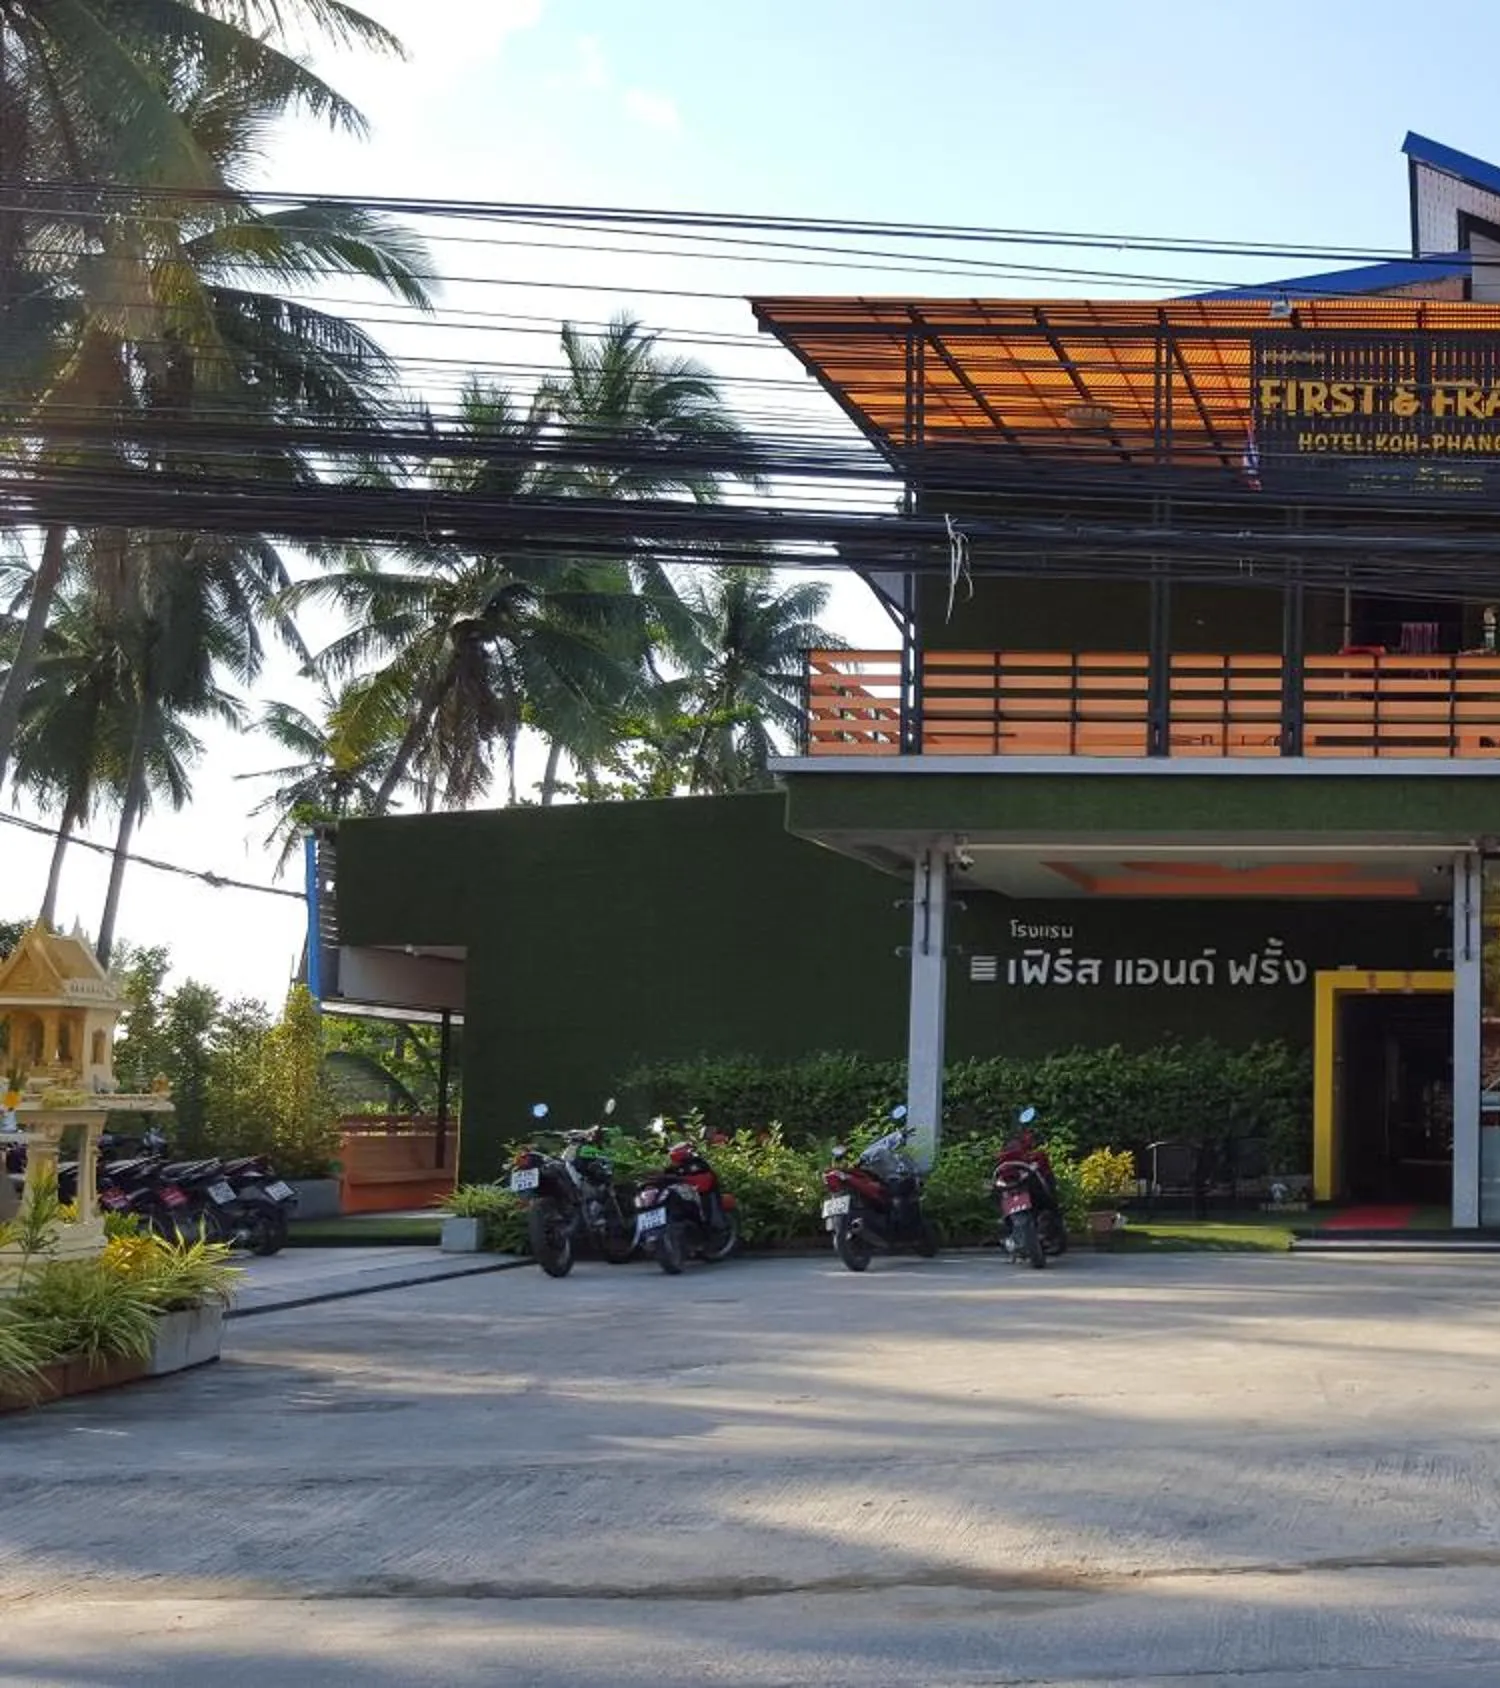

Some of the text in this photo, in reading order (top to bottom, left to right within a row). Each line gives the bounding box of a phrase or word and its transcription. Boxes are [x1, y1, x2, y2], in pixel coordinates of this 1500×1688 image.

[1259, 378, 1375, 417] FIRST
[1394, 378, 1422, 417] &
[1010, 919, 1074, 939] โรงแรม
[1114, 948, 1218, 985] แอนด์
